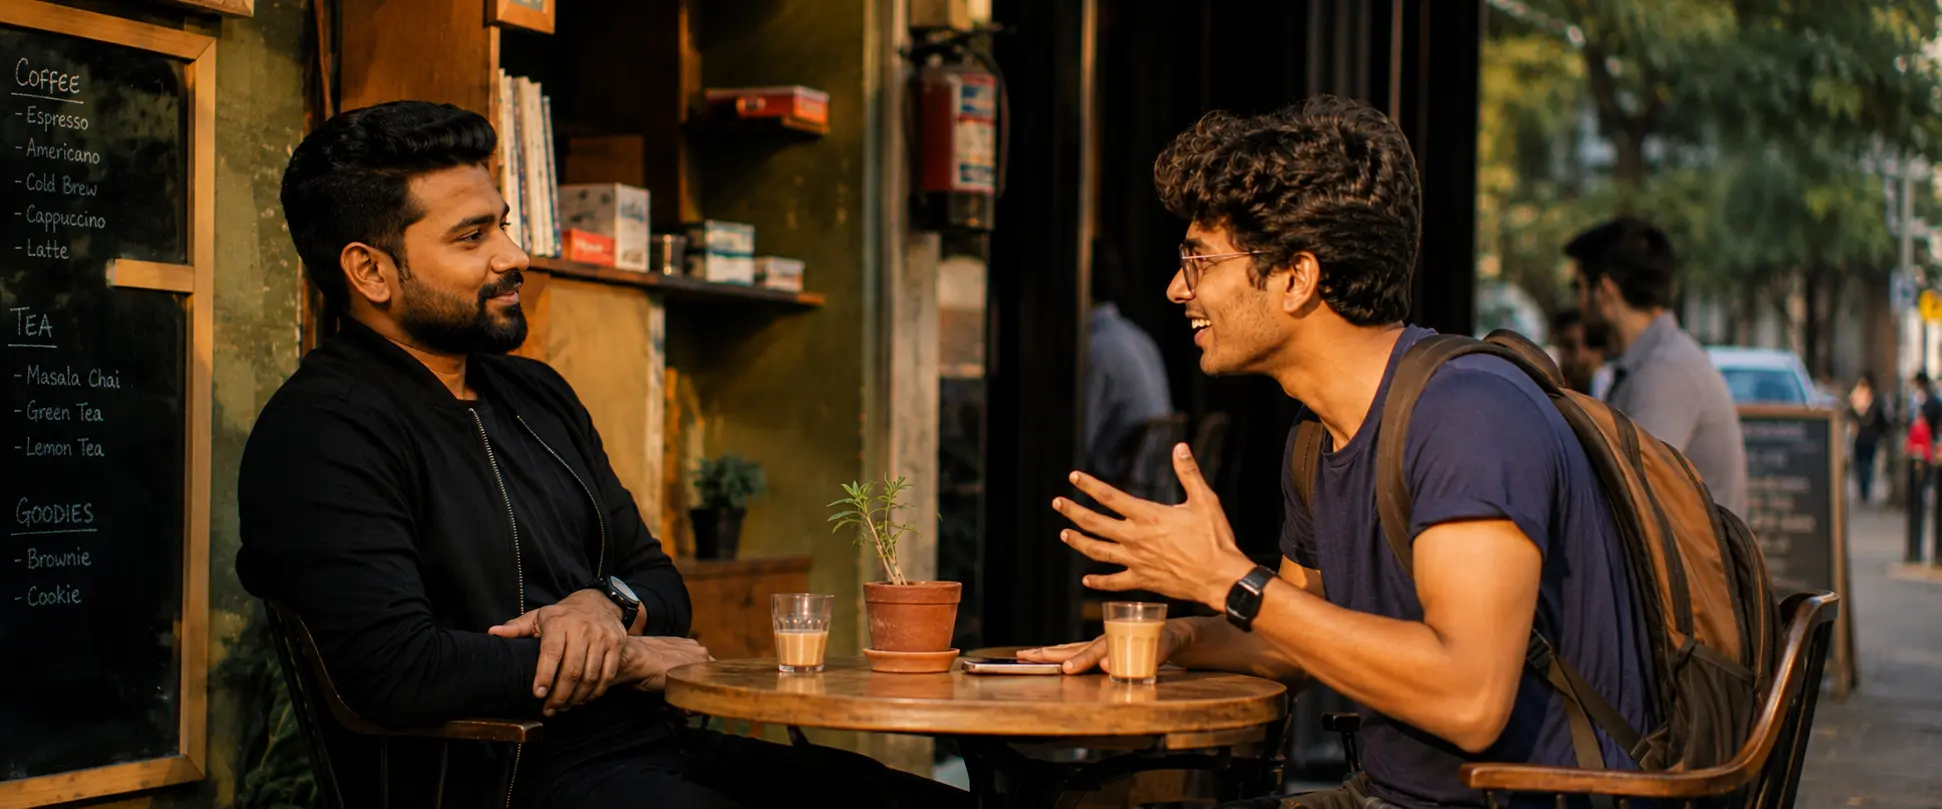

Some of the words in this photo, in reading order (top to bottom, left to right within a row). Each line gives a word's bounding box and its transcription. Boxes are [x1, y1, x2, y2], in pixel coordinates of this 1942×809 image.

[27, 105, 89, 132] Espresso
[26, 137, 100, 165] Americano
[26, 172, 56, 193] Cold
[62, 174, 98, 197] Brew
[26, 204, 106, 233] Cappuccino
[27, 238, 69, 260] Latte
[9, 306, 53, 338] TEA
[26, 365, 81, 387] Masala
[88, 368, 121, 389] Chai
[26, 399, 71, 422] Green
[76, 401, 104, 422] Tea
[26, 436, 72, 457] Lemon
[77, 437, 105, 457] Tea
[15, 496, 94, 527] GOODIES
[27, 546, 92, 570] Brownie
[27, 584, 82, 607] Cookie
